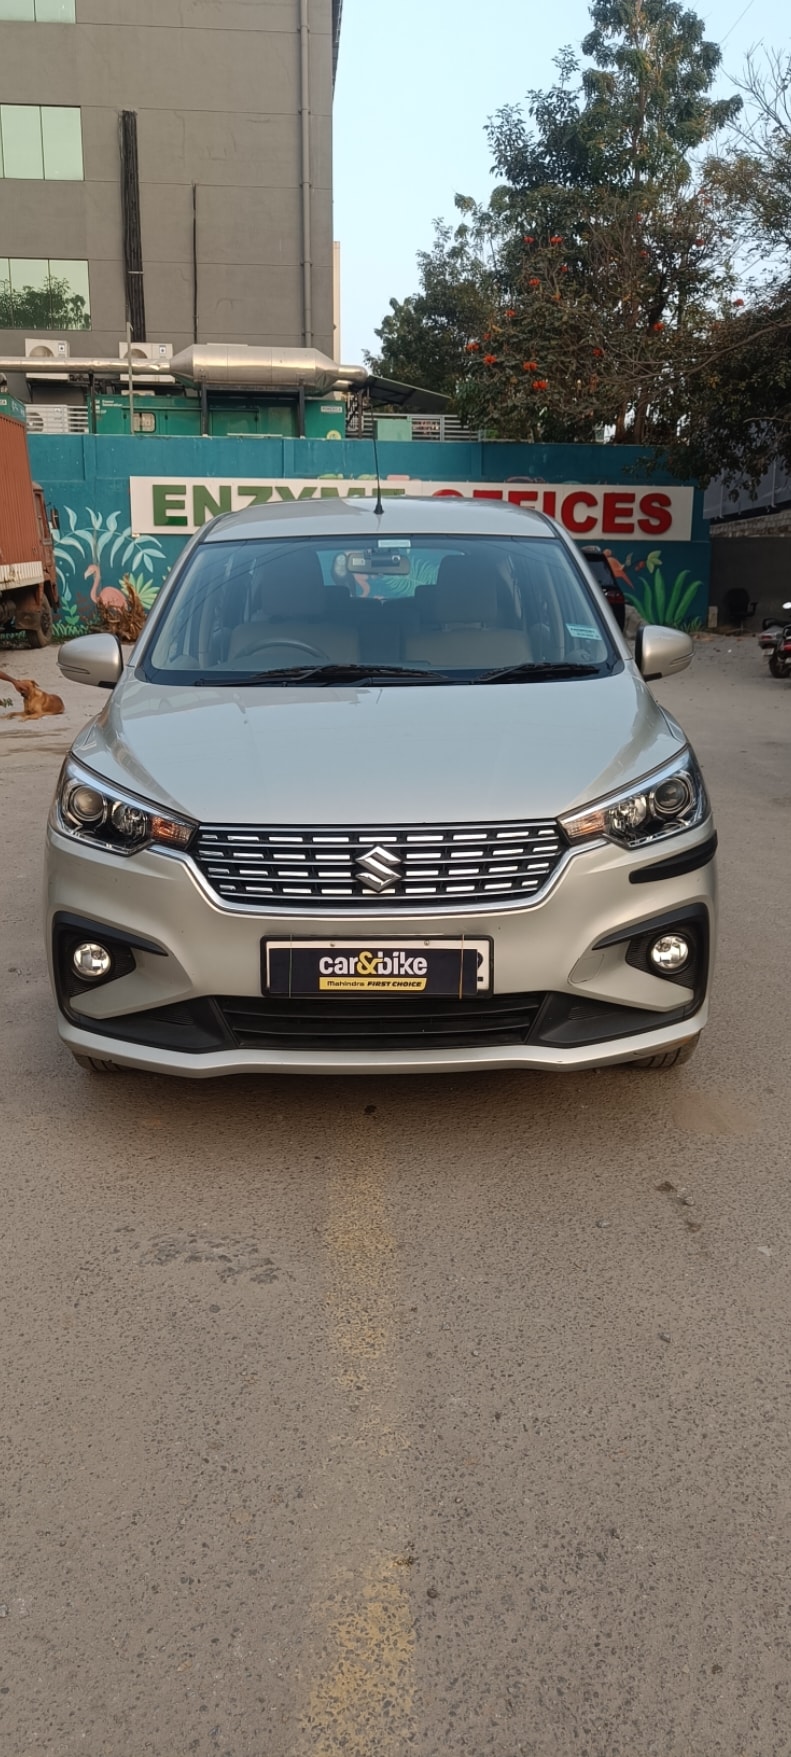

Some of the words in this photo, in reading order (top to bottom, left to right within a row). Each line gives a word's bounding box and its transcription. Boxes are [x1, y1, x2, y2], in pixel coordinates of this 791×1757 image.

[152, 484, 405, 526] ENZ
[431, 489, 673, 535] ICES
[319, 951, 428, 975] car&bike
